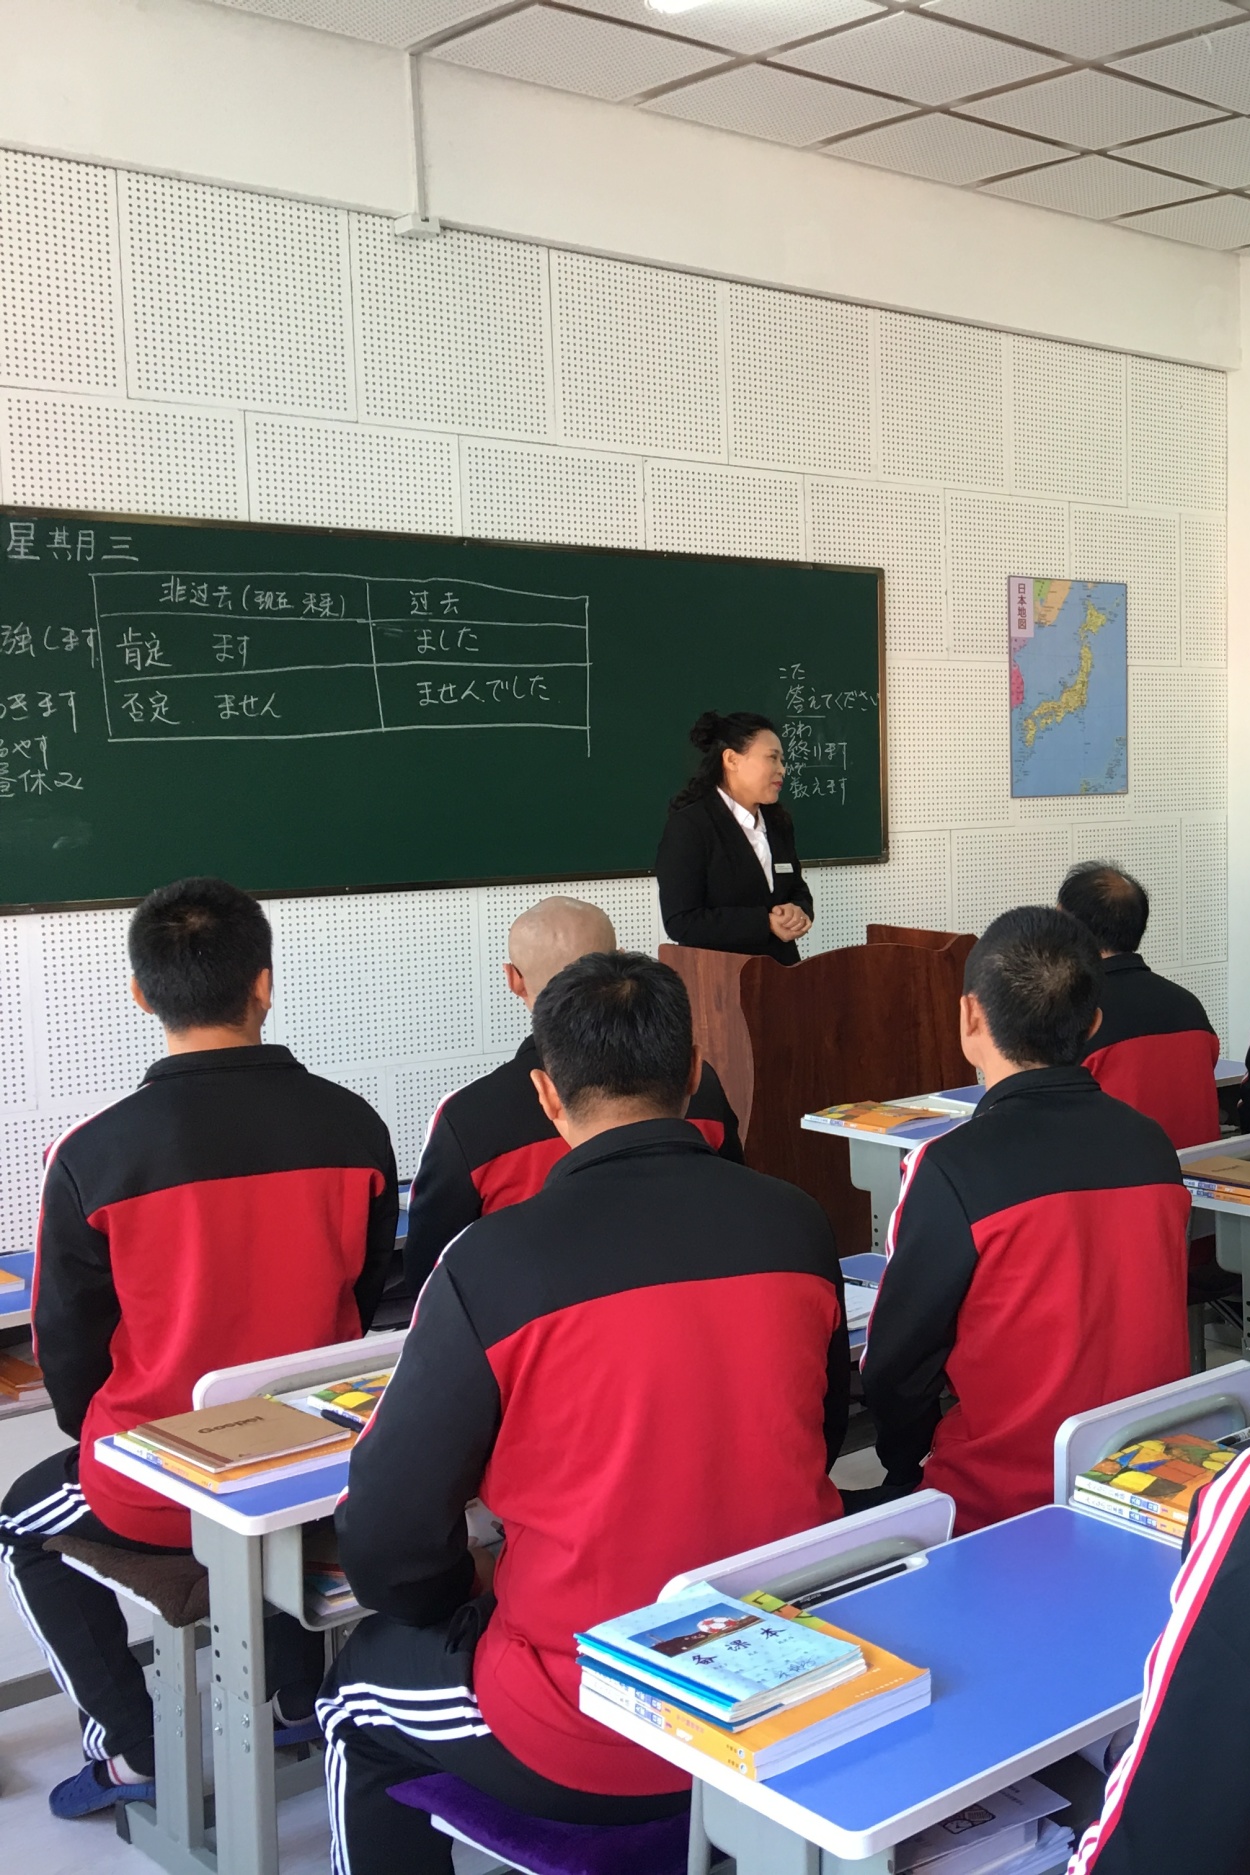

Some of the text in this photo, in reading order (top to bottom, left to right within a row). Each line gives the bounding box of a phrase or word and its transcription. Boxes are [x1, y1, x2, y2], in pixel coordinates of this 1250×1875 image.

[7, 522, 139, 561] 星期三
[410, 590, 459, 616] 过去
[1017, 583, 1027, 630] 日本地図
[116, 627, 172, 671] 肯定
[212, 634, 250, 668] ます
[416, 627, 480, 654] ました
[121, 690, 181, 725] 否定
[214, 693, 282, 720] ません
[417, 675, 550, 706] ませんでした
